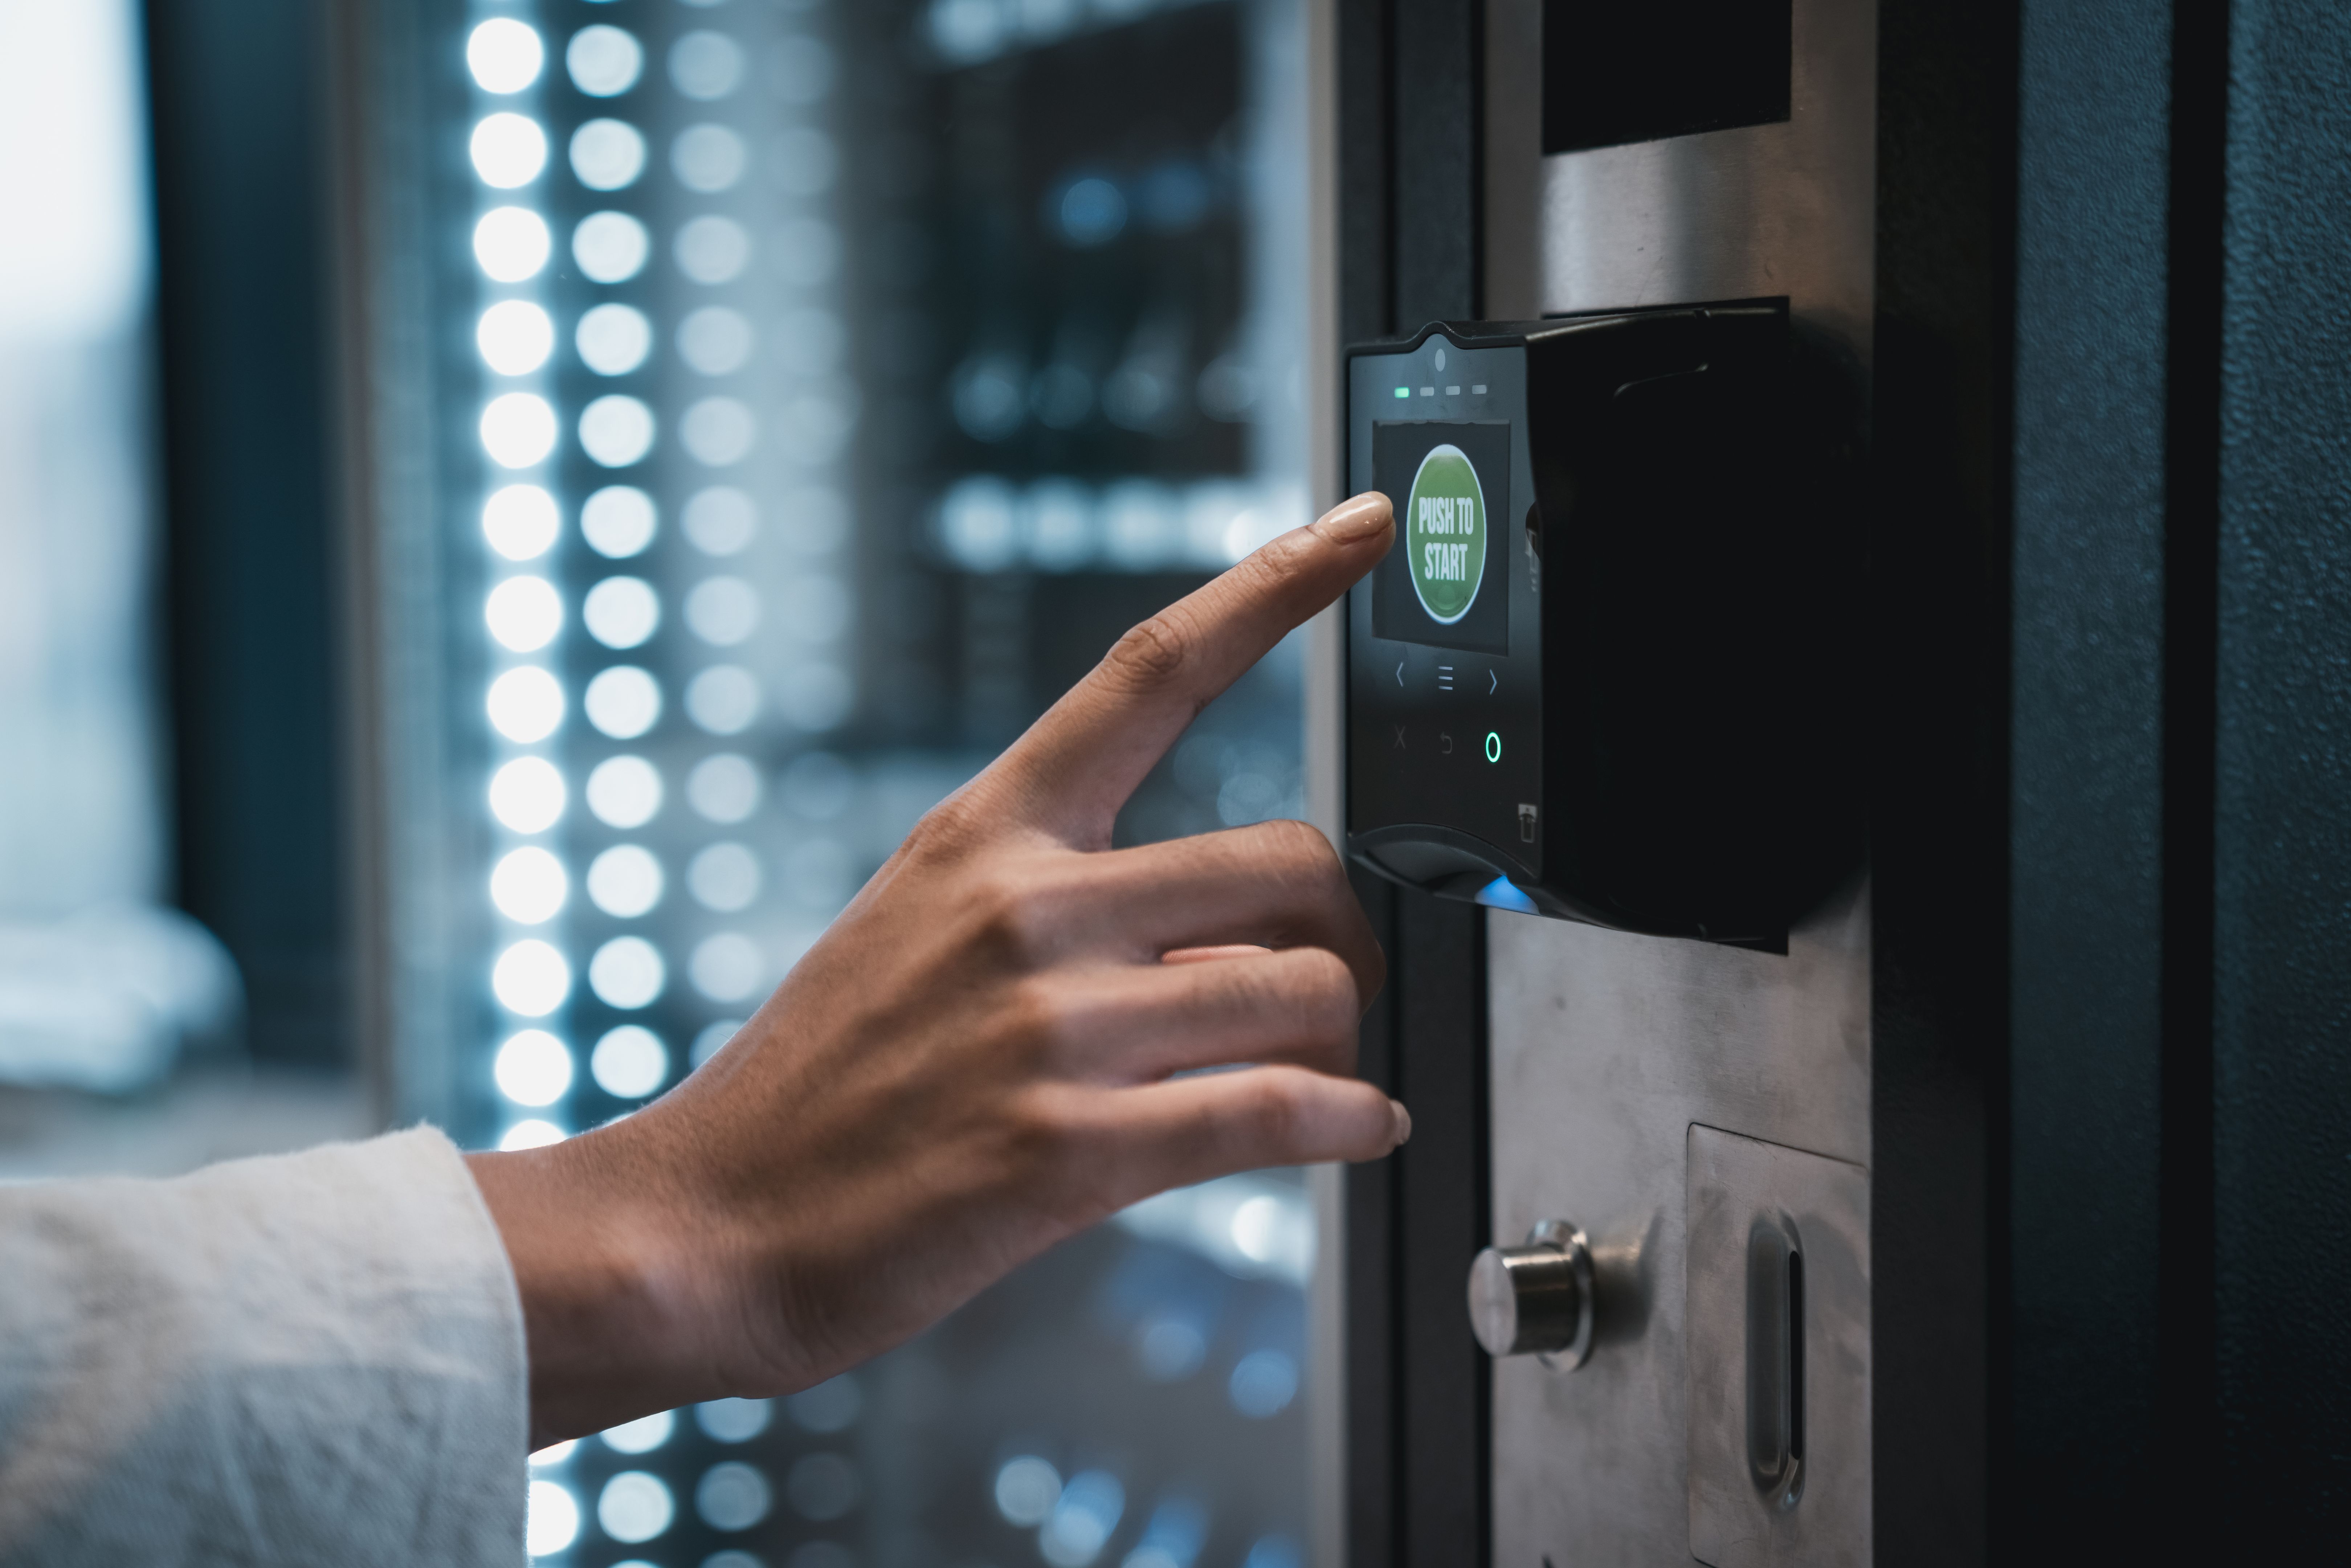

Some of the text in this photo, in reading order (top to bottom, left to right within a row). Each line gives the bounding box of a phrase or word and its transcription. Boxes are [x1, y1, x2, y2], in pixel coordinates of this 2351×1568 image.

[1419, 497, 1474, 535] PUSH TO
[1424, 542, 1468, 581] START
